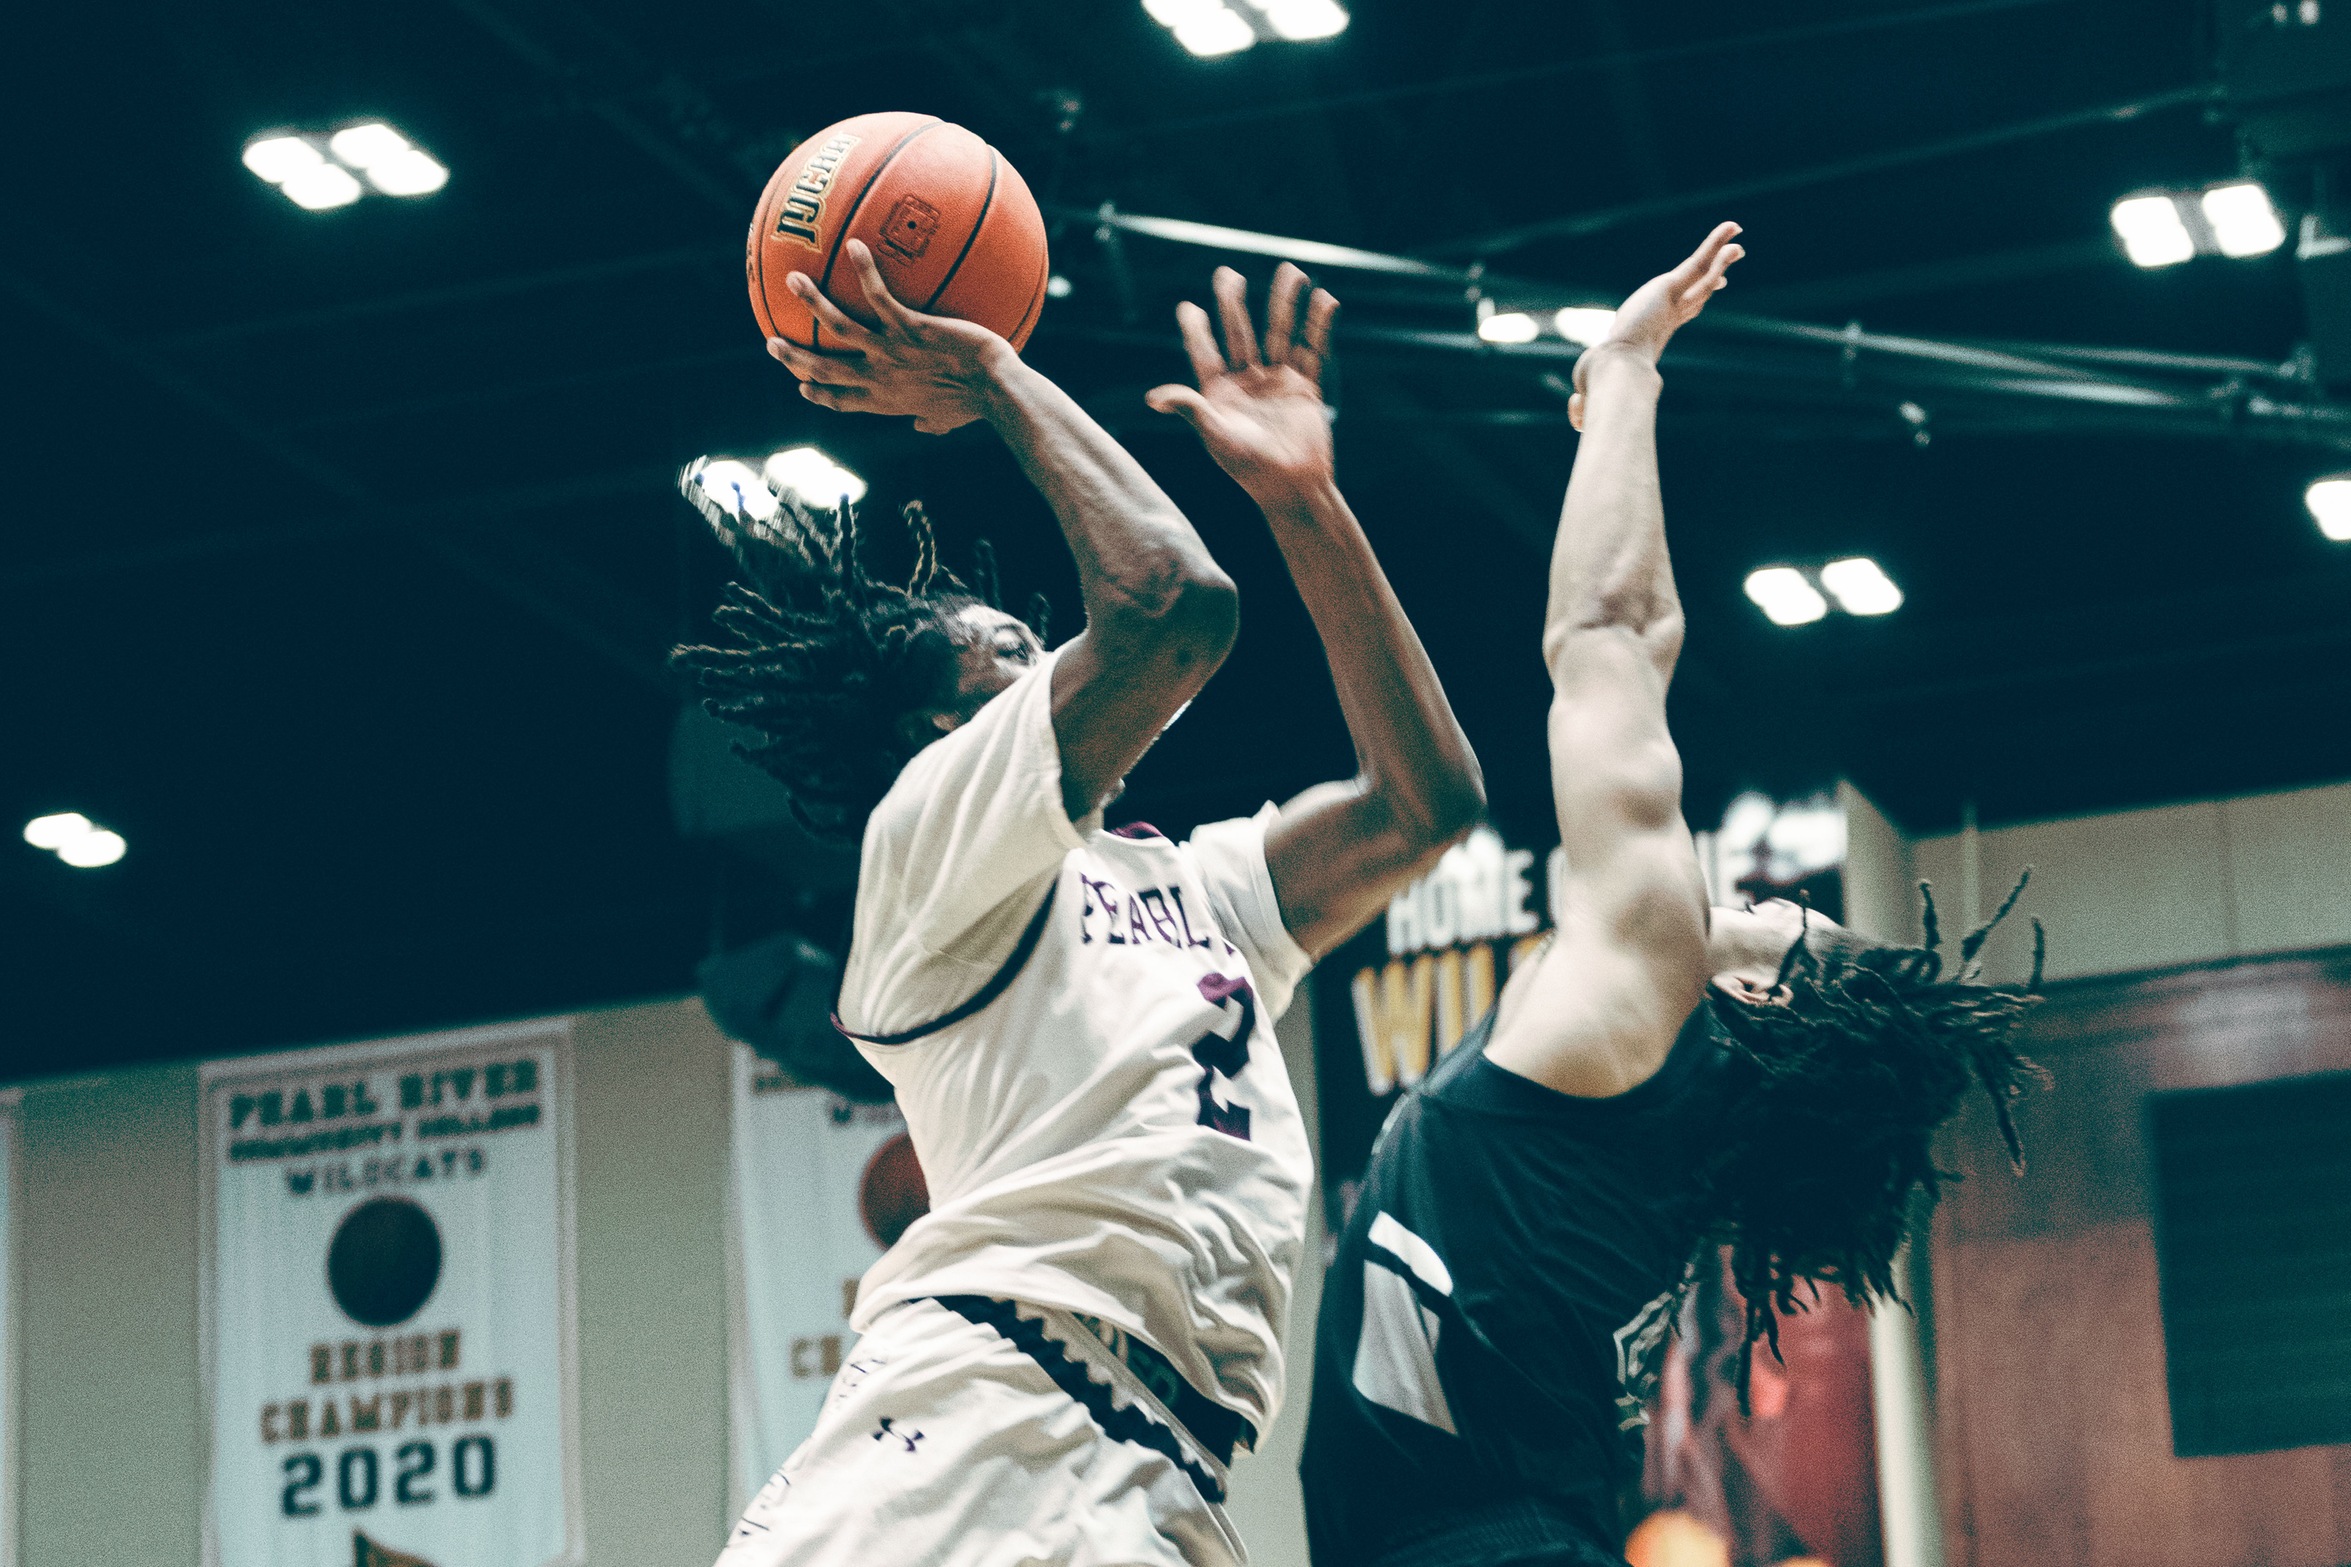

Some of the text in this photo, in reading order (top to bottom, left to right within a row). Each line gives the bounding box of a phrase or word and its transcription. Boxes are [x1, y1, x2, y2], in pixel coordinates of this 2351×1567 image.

[1387, 844, 1540, 955] HOME
[1191, 972, 1256, 1142] 2
[280, 1434, 498, 1519] 2020
